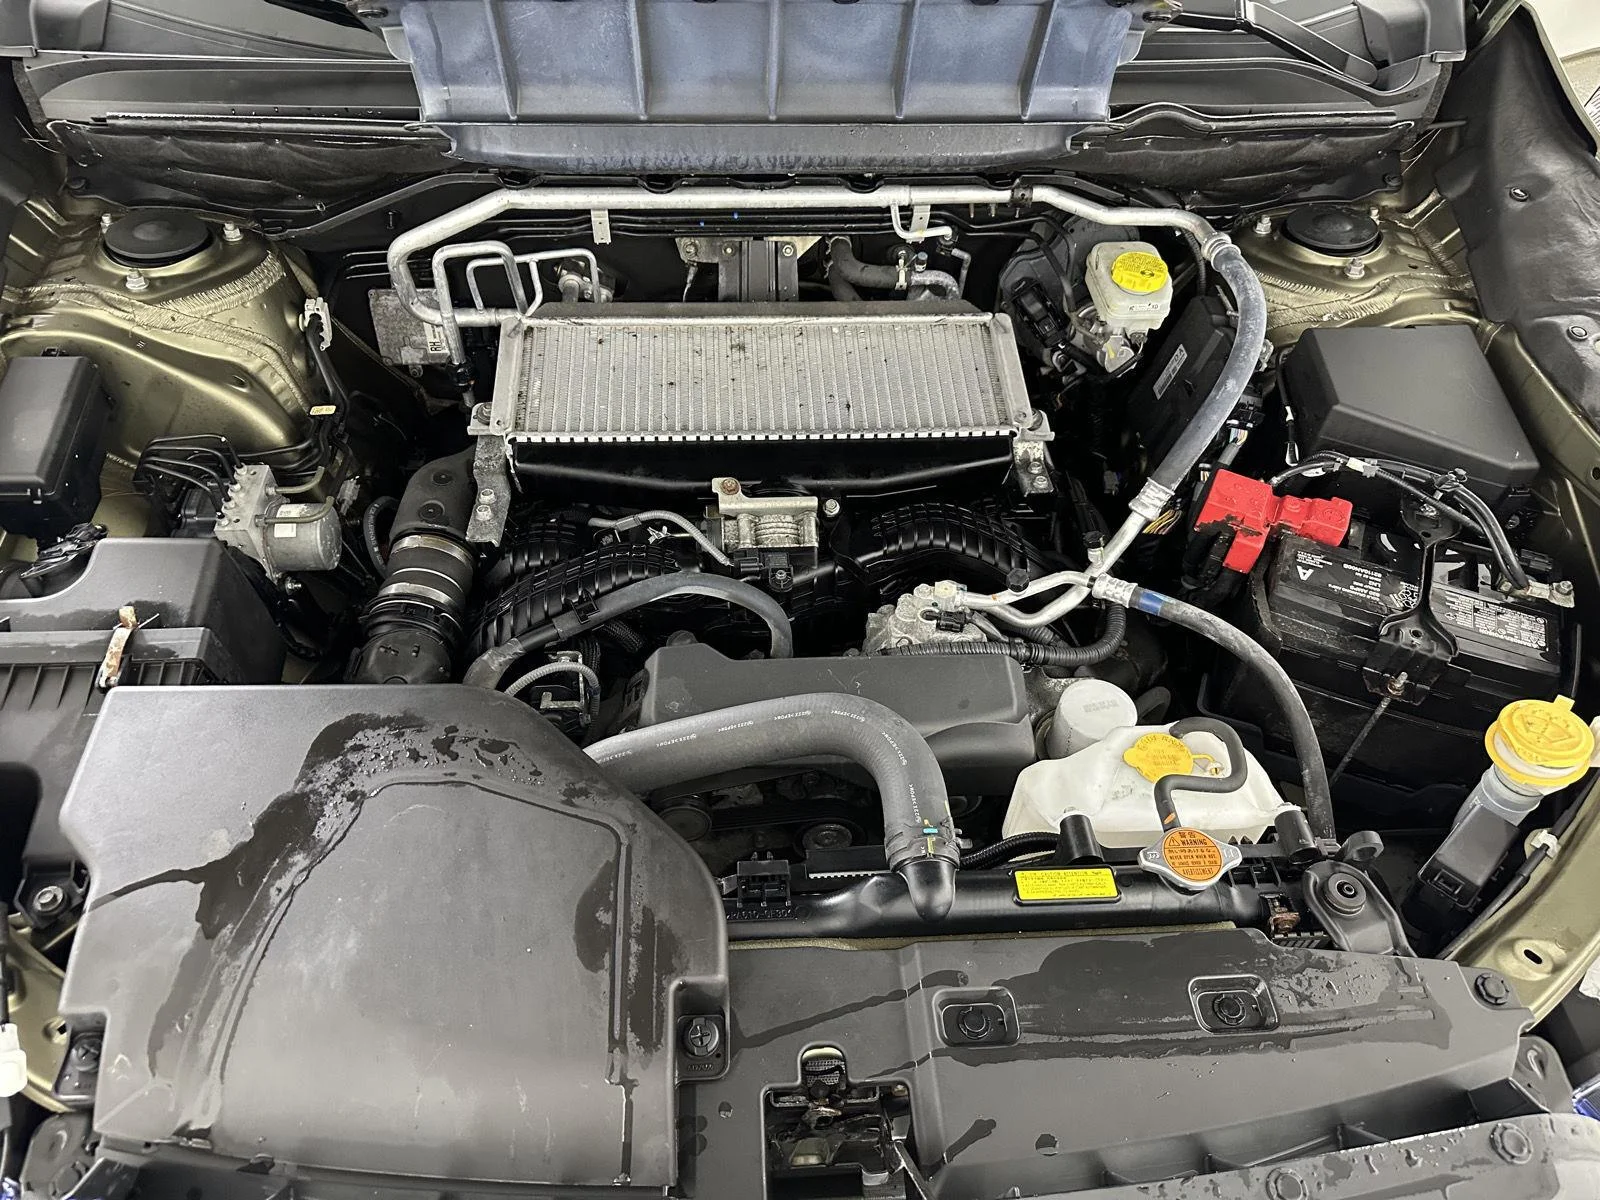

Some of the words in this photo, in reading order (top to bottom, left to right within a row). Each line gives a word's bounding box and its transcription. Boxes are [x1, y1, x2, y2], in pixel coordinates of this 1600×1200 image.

[429, 341, 442, 352] RH
[1296, 565, 1315, 581] A
[1180, 838, 1207, 846] WARNING
